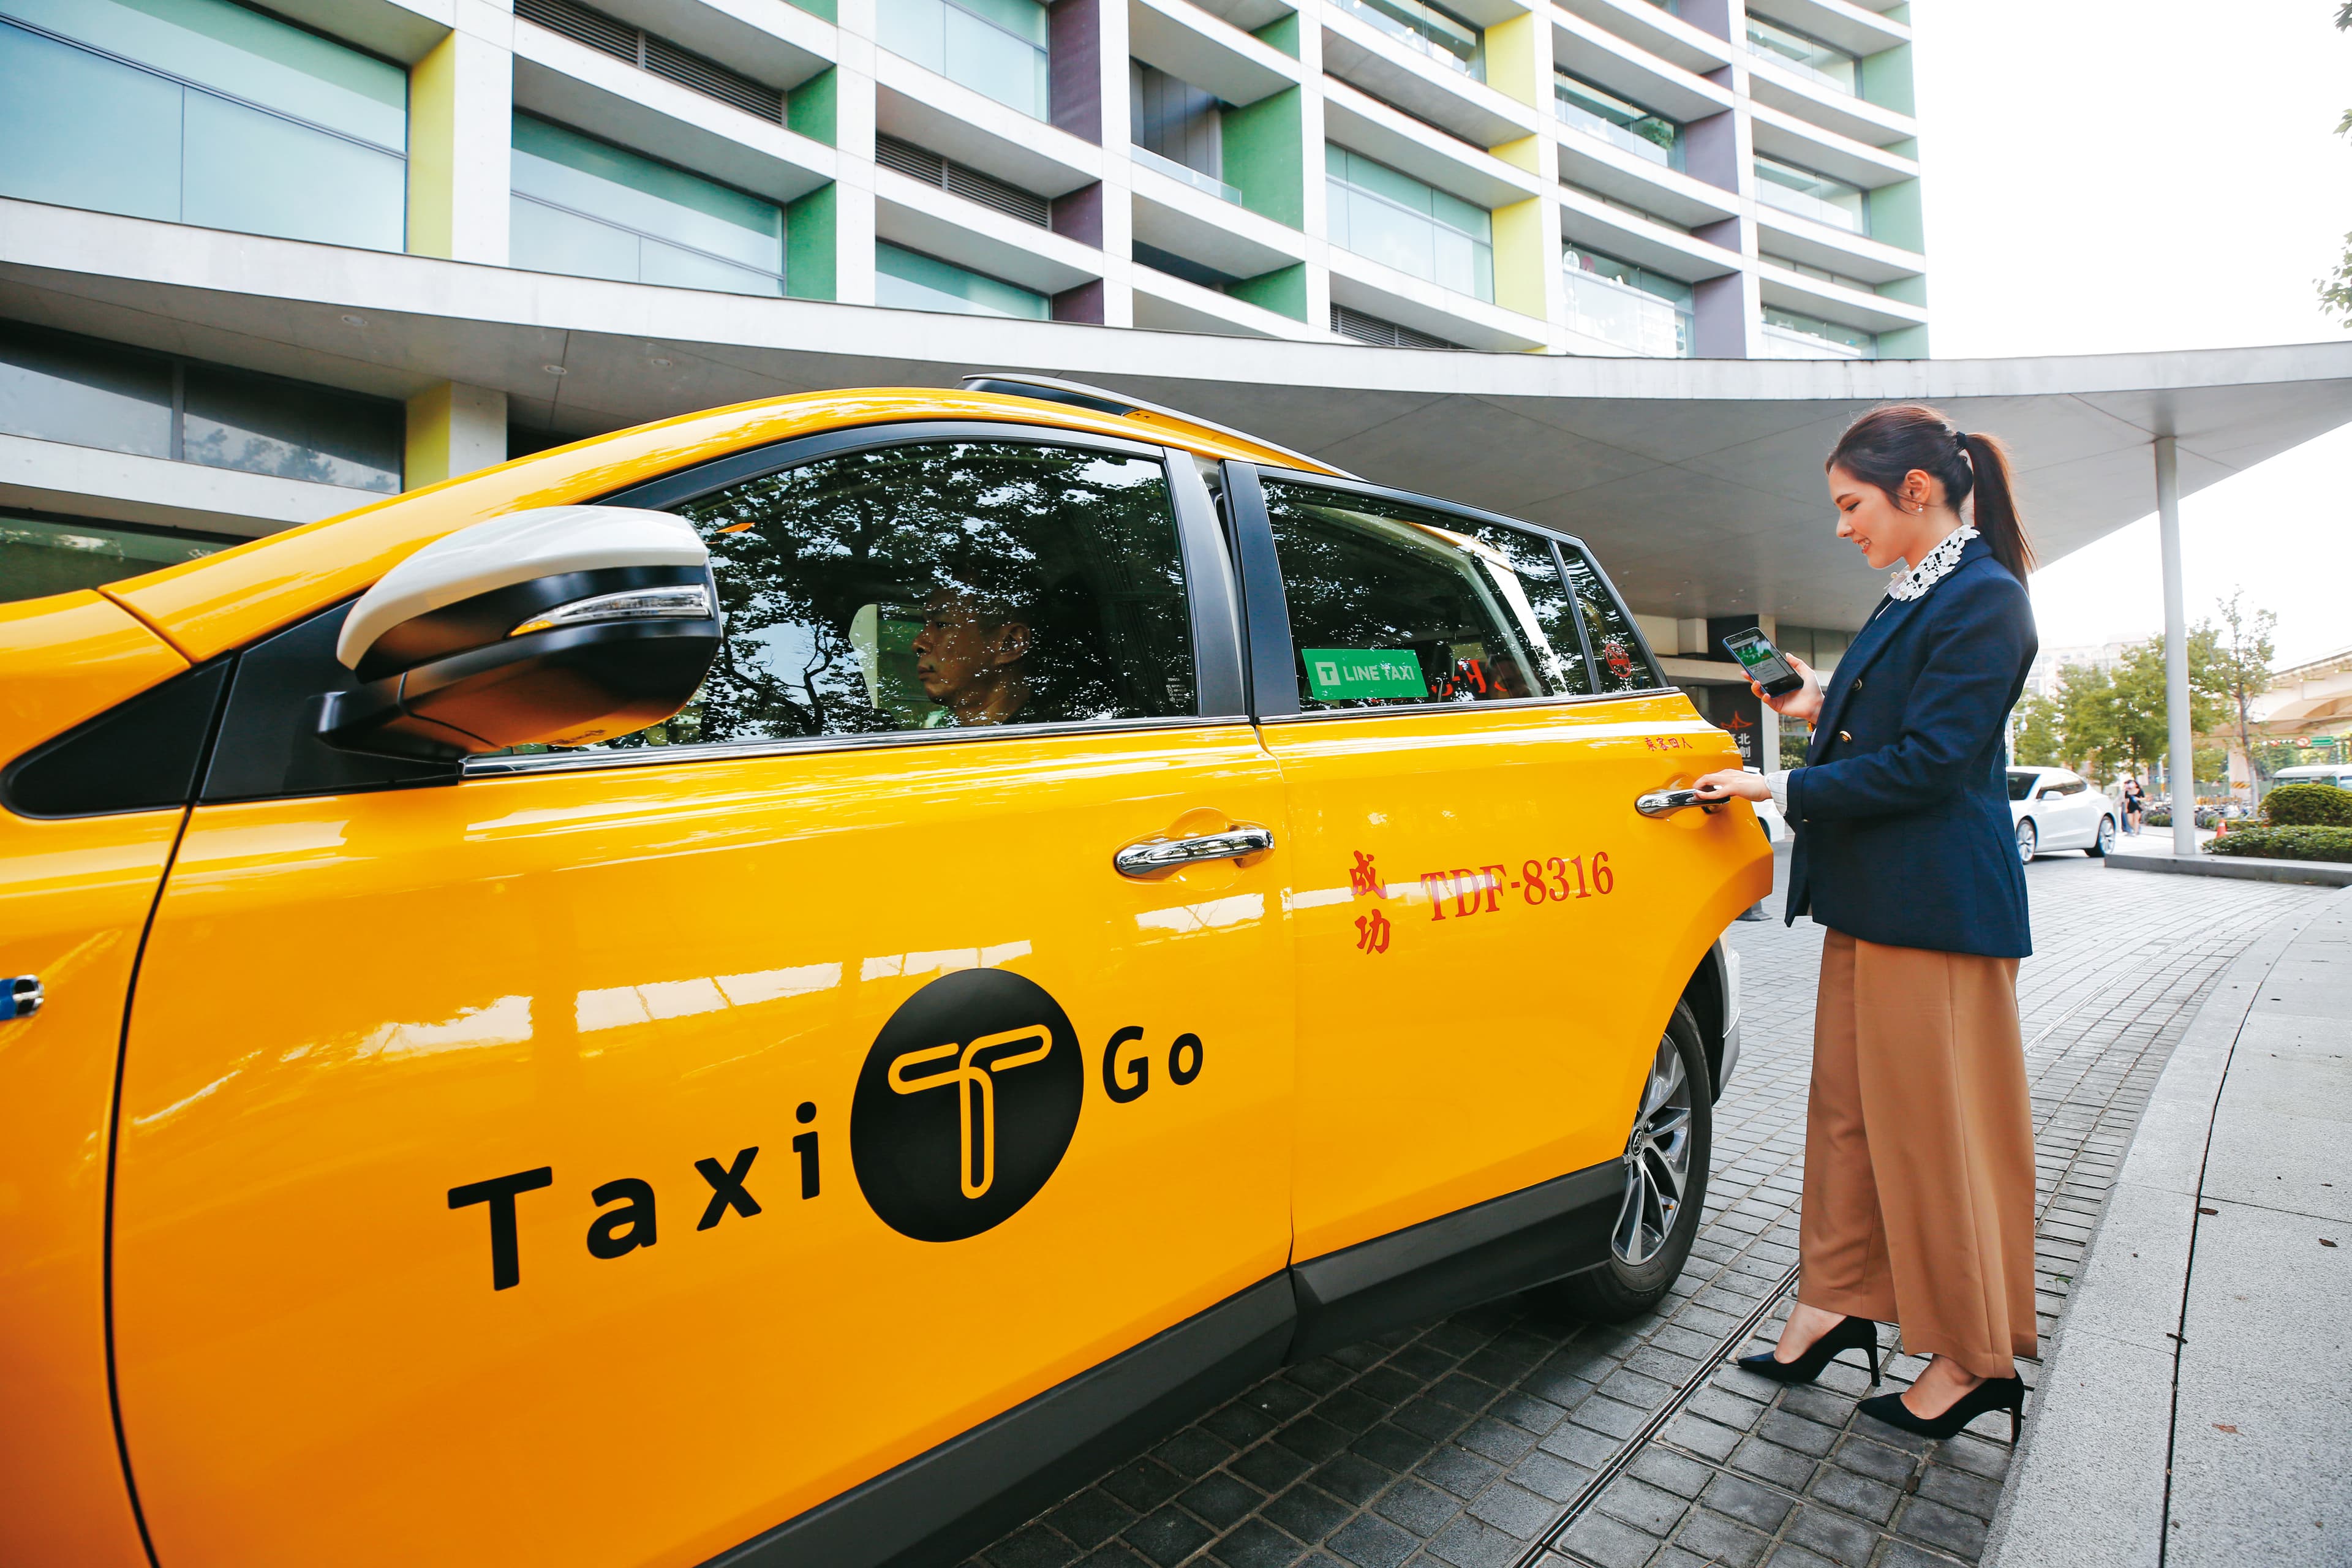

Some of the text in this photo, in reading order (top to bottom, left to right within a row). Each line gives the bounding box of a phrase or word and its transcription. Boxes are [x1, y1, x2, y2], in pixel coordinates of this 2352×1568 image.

[1343, 666, 1381, 681] LINE
[1381, 666, 1415, 680] TAXI
[1349, 850, 1391, 955] 成功
[1420, 851, 1614, 922] TDF-8316
[447, 1101, 820, 1291] Taxi
[1102, 1025, 1204, 1104] Go
